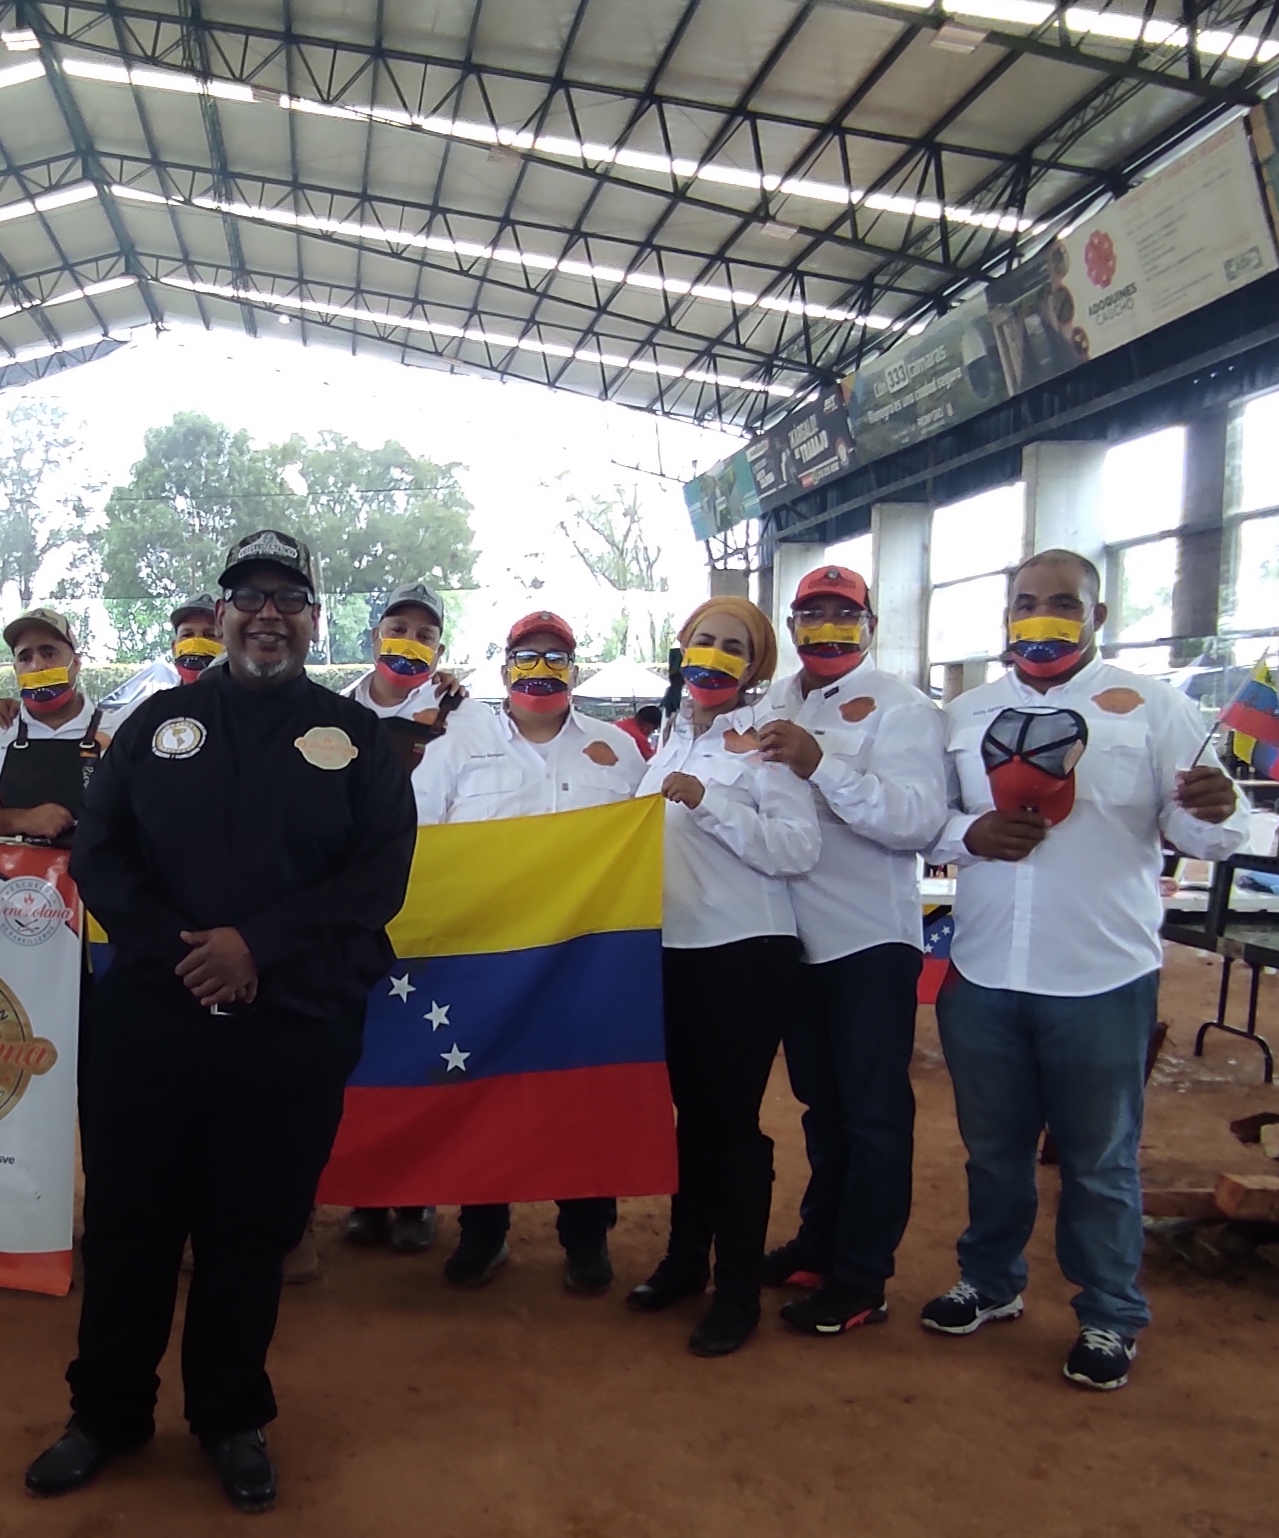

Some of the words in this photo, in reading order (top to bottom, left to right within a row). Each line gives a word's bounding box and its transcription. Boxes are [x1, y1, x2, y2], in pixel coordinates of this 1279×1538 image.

[1088, 282, 1137, 317] ADOQUINES
[1096, 299, 1134, 326] CAUCHO
[887, 366, 907, 390] 333
